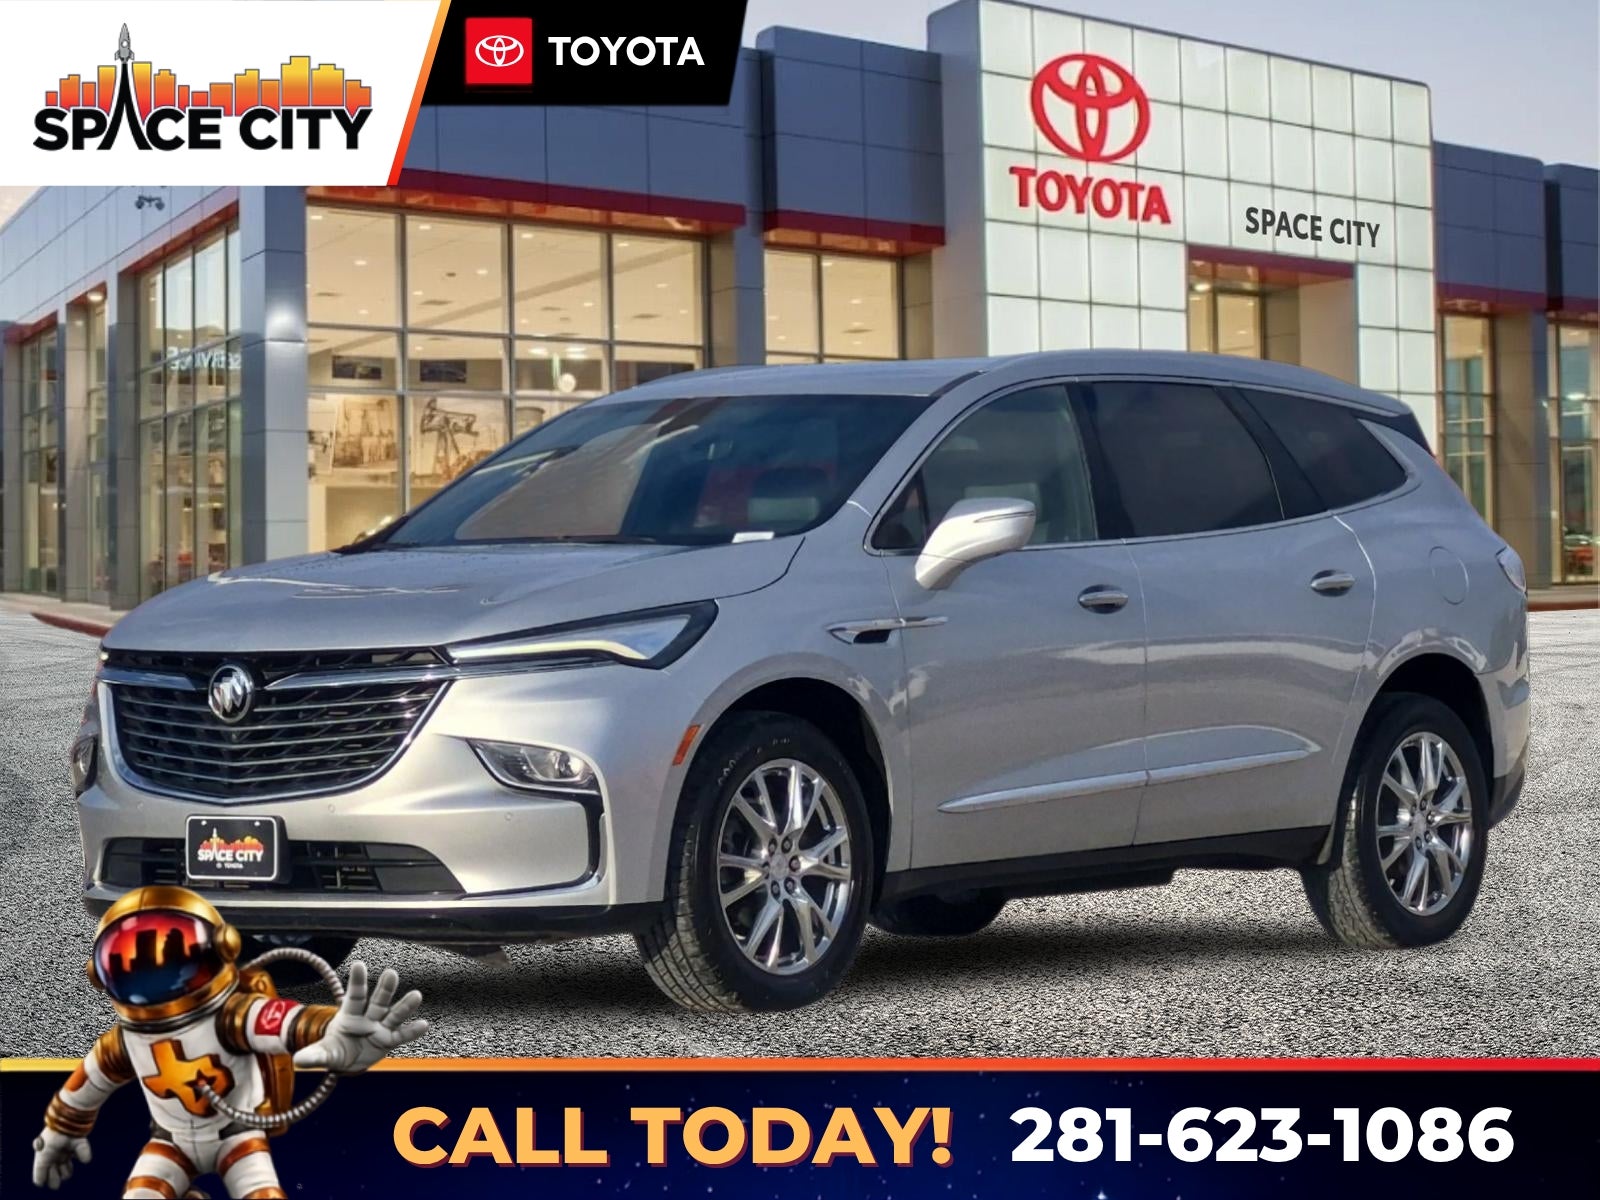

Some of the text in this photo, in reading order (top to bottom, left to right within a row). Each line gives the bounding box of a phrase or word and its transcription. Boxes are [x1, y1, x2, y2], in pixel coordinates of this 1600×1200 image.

[1009, 166, 1172, 224] TOYOTA
[1245, 206, 1380, 248] SPACE CITY
[197, 848, 264, 862] SPACE CITY
